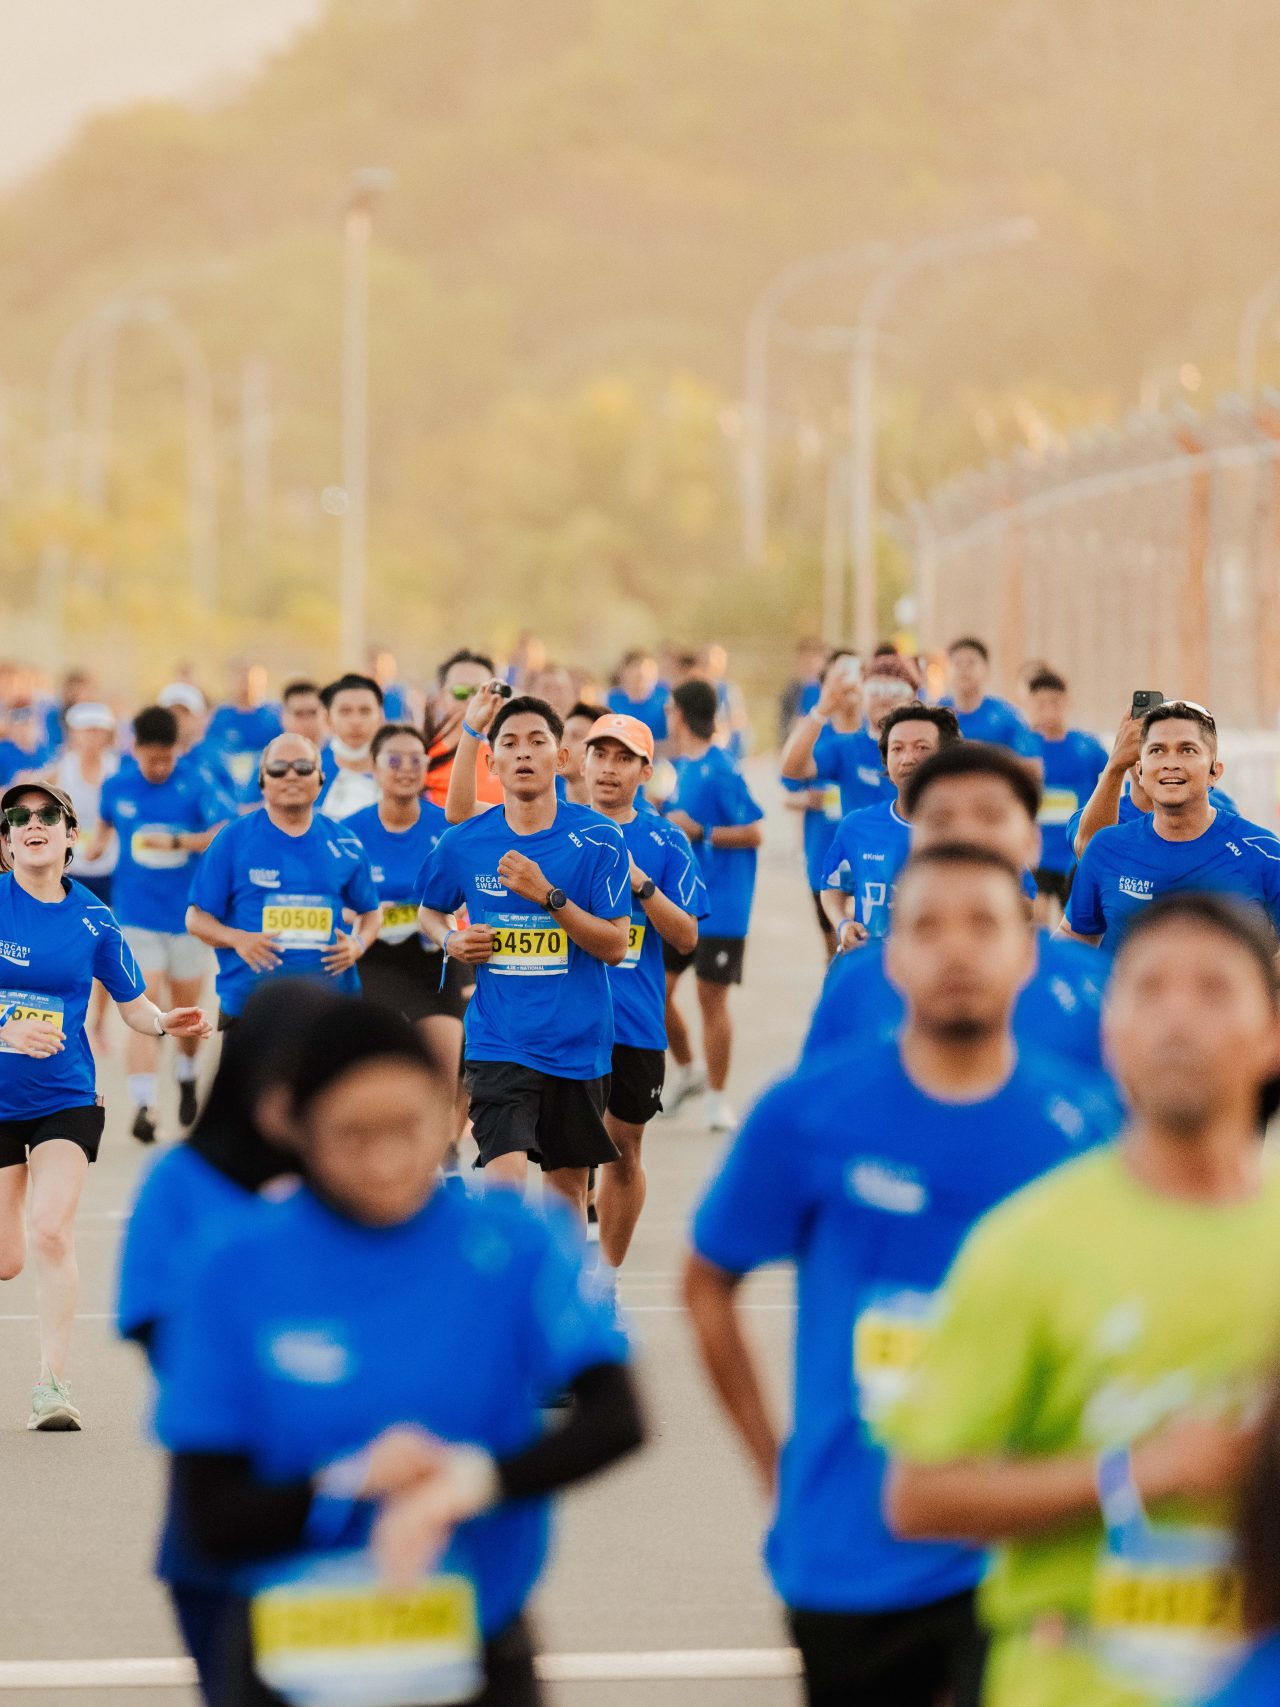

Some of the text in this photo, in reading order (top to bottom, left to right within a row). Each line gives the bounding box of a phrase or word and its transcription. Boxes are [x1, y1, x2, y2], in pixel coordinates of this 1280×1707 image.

[568, 832, 583, 848] 2XU
[1225, 841, 1242, 857] 2XU
[1118, 883, 1149, 893] SWEAT
[1119, 877, 1154, 888] POCARI
[81, 917, 99, 936] 2XU
[267, 909, 328, 930] 50508
[492, 931, 561, 954] 54570
